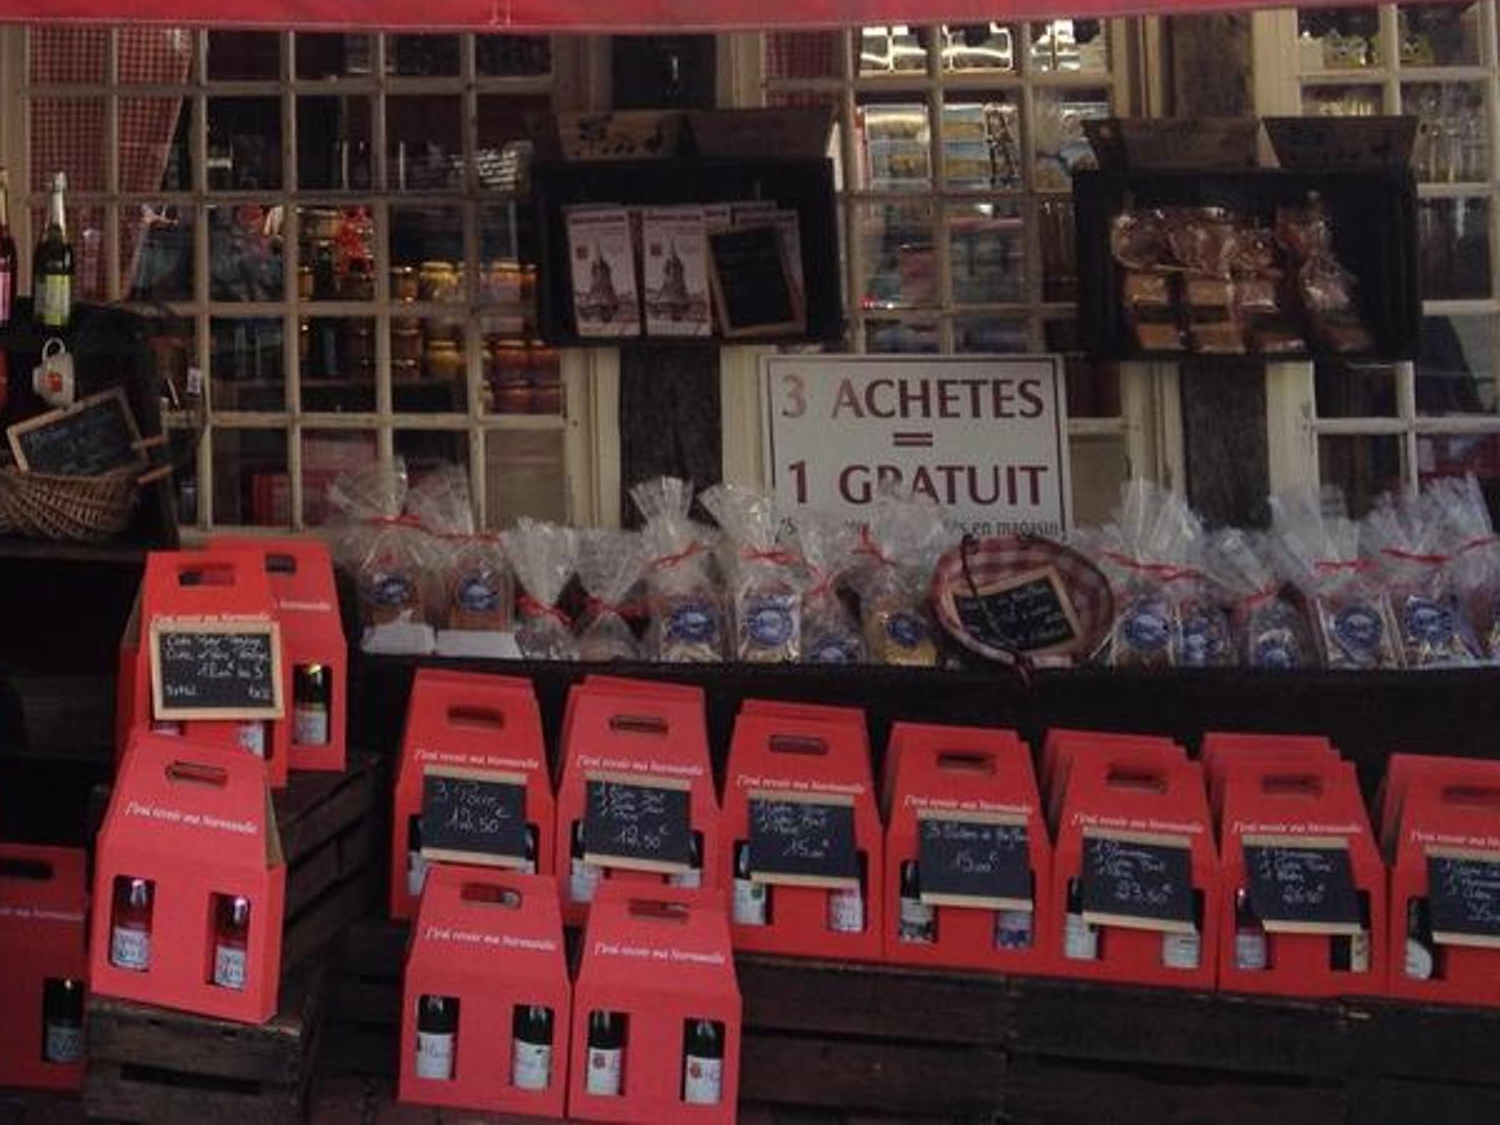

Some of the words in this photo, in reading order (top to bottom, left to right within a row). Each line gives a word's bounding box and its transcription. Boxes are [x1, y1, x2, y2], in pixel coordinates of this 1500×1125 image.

[781, 374, 807, 418] 3
[832, 378, 1045, 419] ACHETES
[787, 459, 808, 504] 1
[839, 465, 1048, 506] GRATUIT
